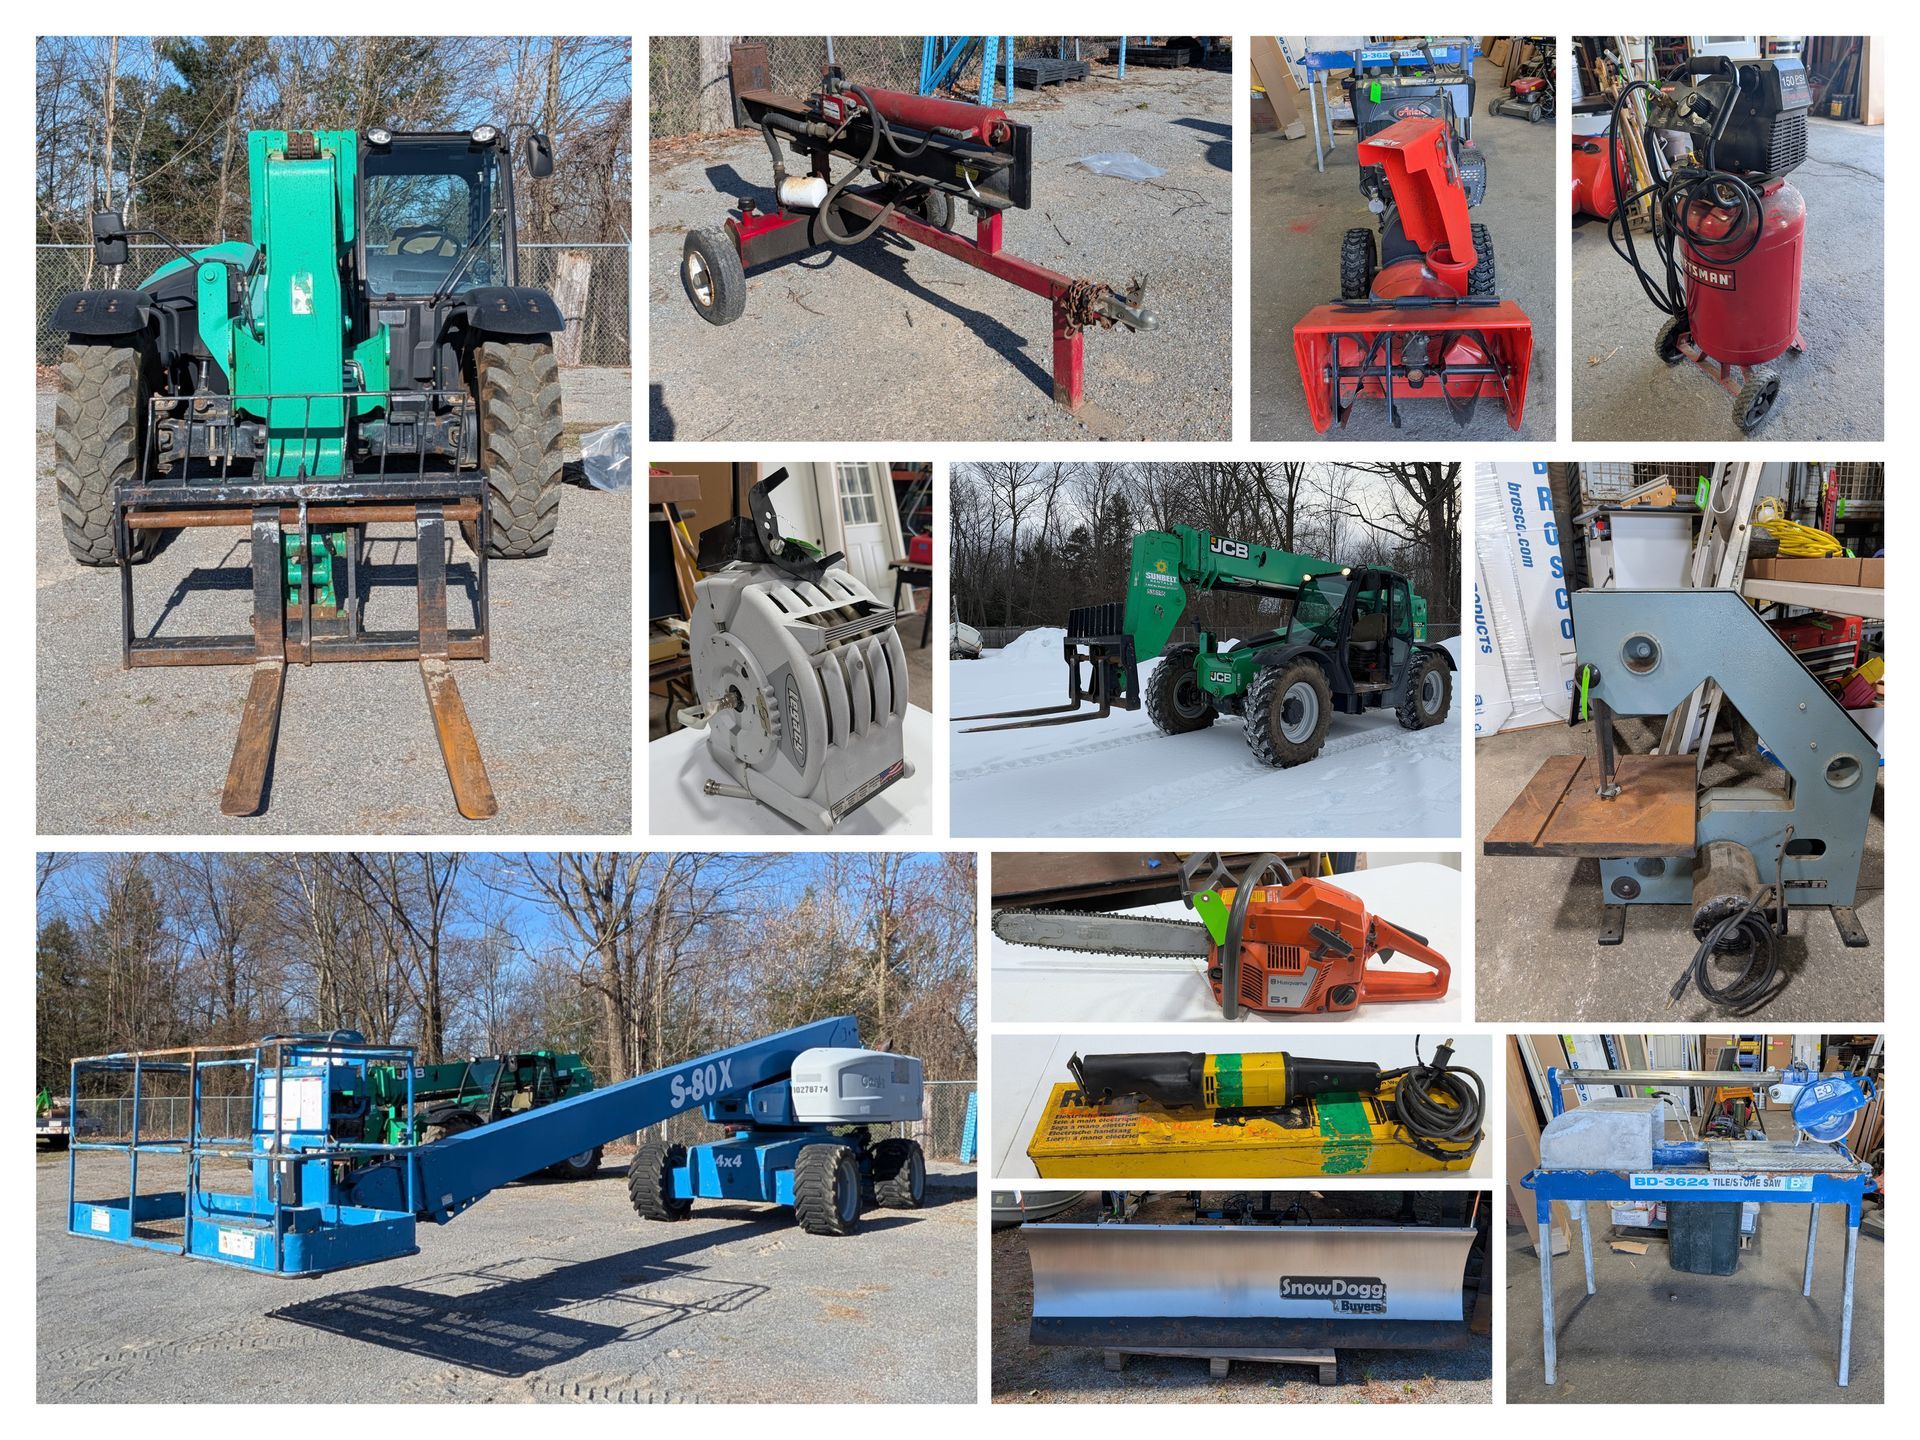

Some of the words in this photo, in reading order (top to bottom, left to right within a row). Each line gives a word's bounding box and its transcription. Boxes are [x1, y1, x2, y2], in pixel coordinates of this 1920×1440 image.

[1782, 75, 1795, 87] 150
[1684, 258, 1729, 286] FTSMAN
[1507, 481, 1534, 568] brosco.com
[1211, 538, 1248, 559] JCB
[1145, 572, 1177, 583] SUNBELT
[1210, 671, 1232, 683] JCB
[1270, 995, 1288, 1004] 51
[396, 1068, 425, 1080] JB
[670, 1058, 734, 1109] S-80X
[715, 1153, 742, 1168] 4x4
[1634, 1177, 1710, 1187] BD-3624
[1763, 1178, 1782, 1188] SAW
[1281, 1278, 1384, 1299] SnowDogg
[1341, 1300, 1382, 1313] Buyers
